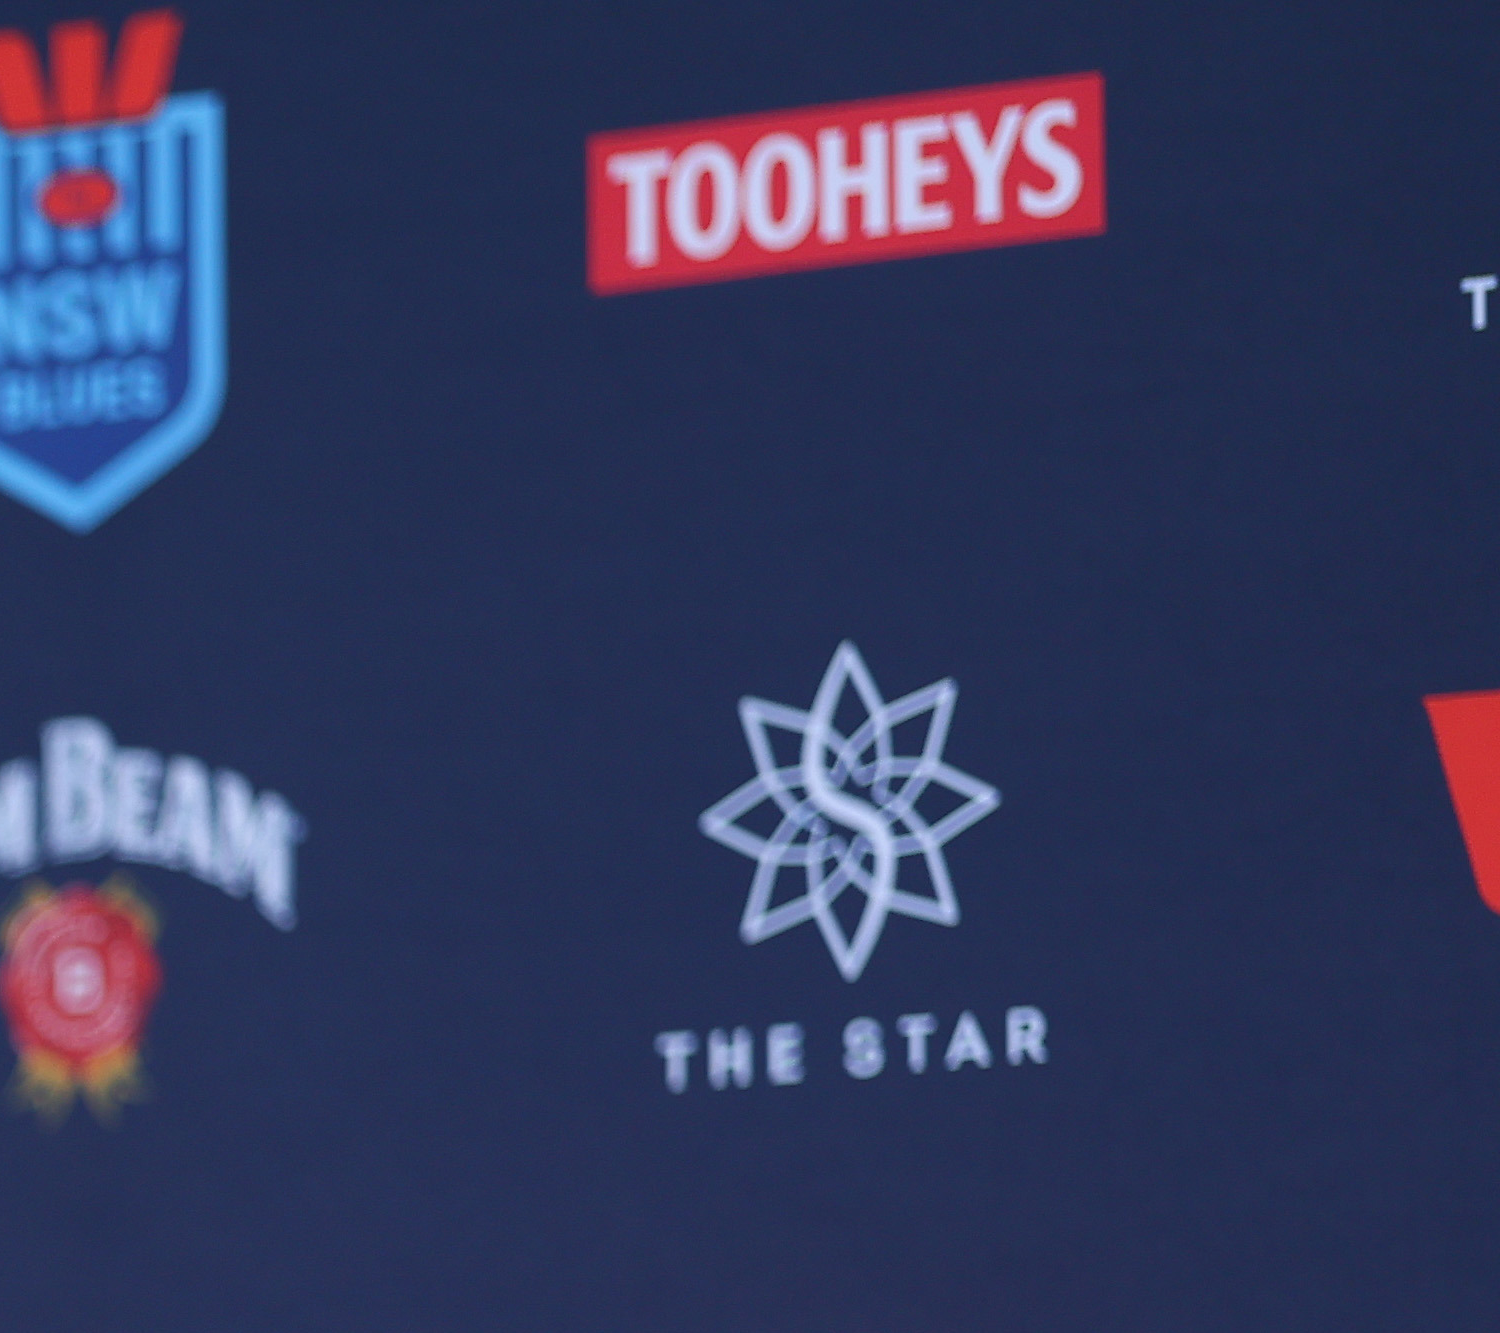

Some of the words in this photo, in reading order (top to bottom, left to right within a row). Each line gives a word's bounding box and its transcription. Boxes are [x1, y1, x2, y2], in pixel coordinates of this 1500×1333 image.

[606, 97, 1085, 268] TOOHEYS
[40, 715, 303, 932] BEAM
[653, 1029, 805, 1094] THE
[842, 1004, 1049, 1080] STAR
